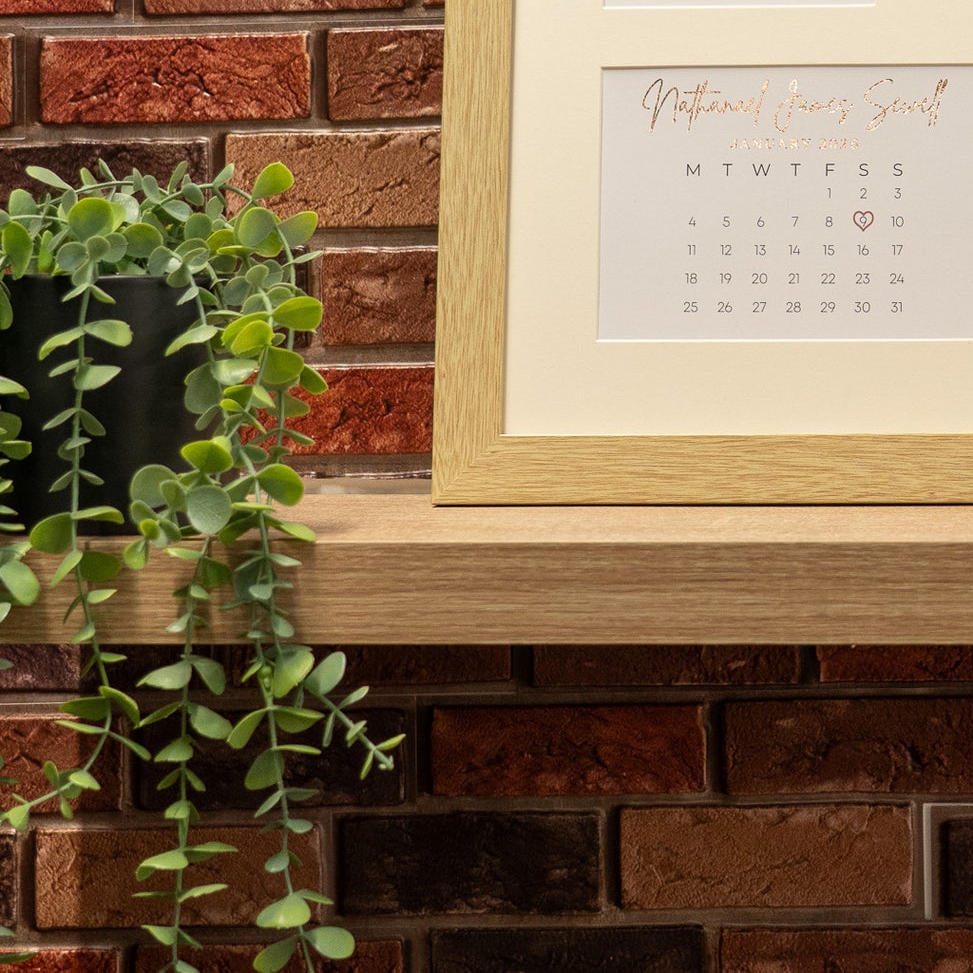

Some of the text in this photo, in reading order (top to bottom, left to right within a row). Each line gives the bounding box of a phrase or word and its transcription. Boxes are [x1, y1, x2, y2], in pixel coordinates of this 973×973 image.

[642, 78, 949, 133] Nathanael James Sewell
[730, 137, 811, 150] JANUARY
[686, 162, 904, 177] M T W T F S S
[826, 187, 902, 200] 1 2 3
[687, 214, 905, 228] 4 5 6 7 8 9 10
[687, 244, 904, 257] 11 12 13 14 15 16 17
[684, 272, 905, 285] 18 19 20 21 22 23 24
[683, 301, 903, 315] 25 26 27 28 29 30 31
